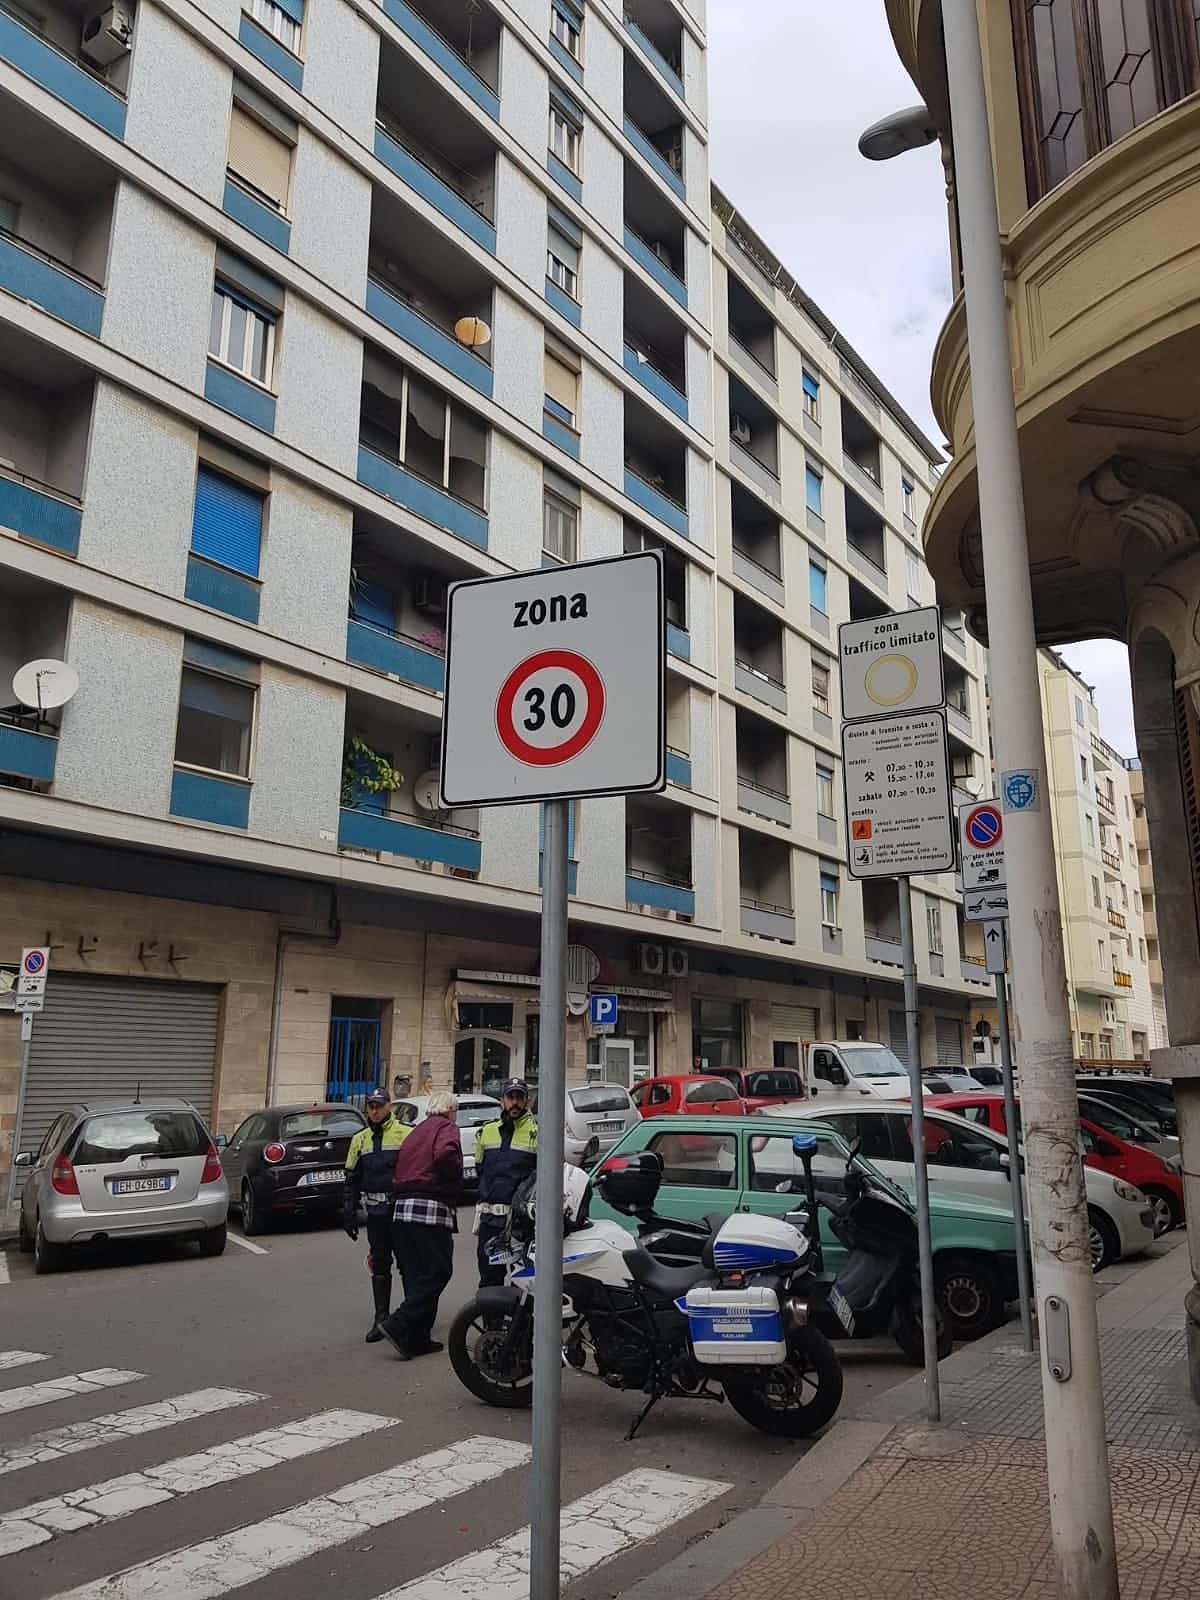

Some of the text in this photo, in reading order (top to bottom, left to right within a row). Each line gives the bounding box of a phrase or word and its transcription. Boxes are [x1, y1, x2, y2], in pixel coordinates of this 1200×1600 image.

[513, 592, 588, 628] zona
[874, 623, 899, 634] zona
[844, 630, 935, 655] traffico limitato
[523, 684, 576, 731] 30
[597, 998, 613, 1021] P
